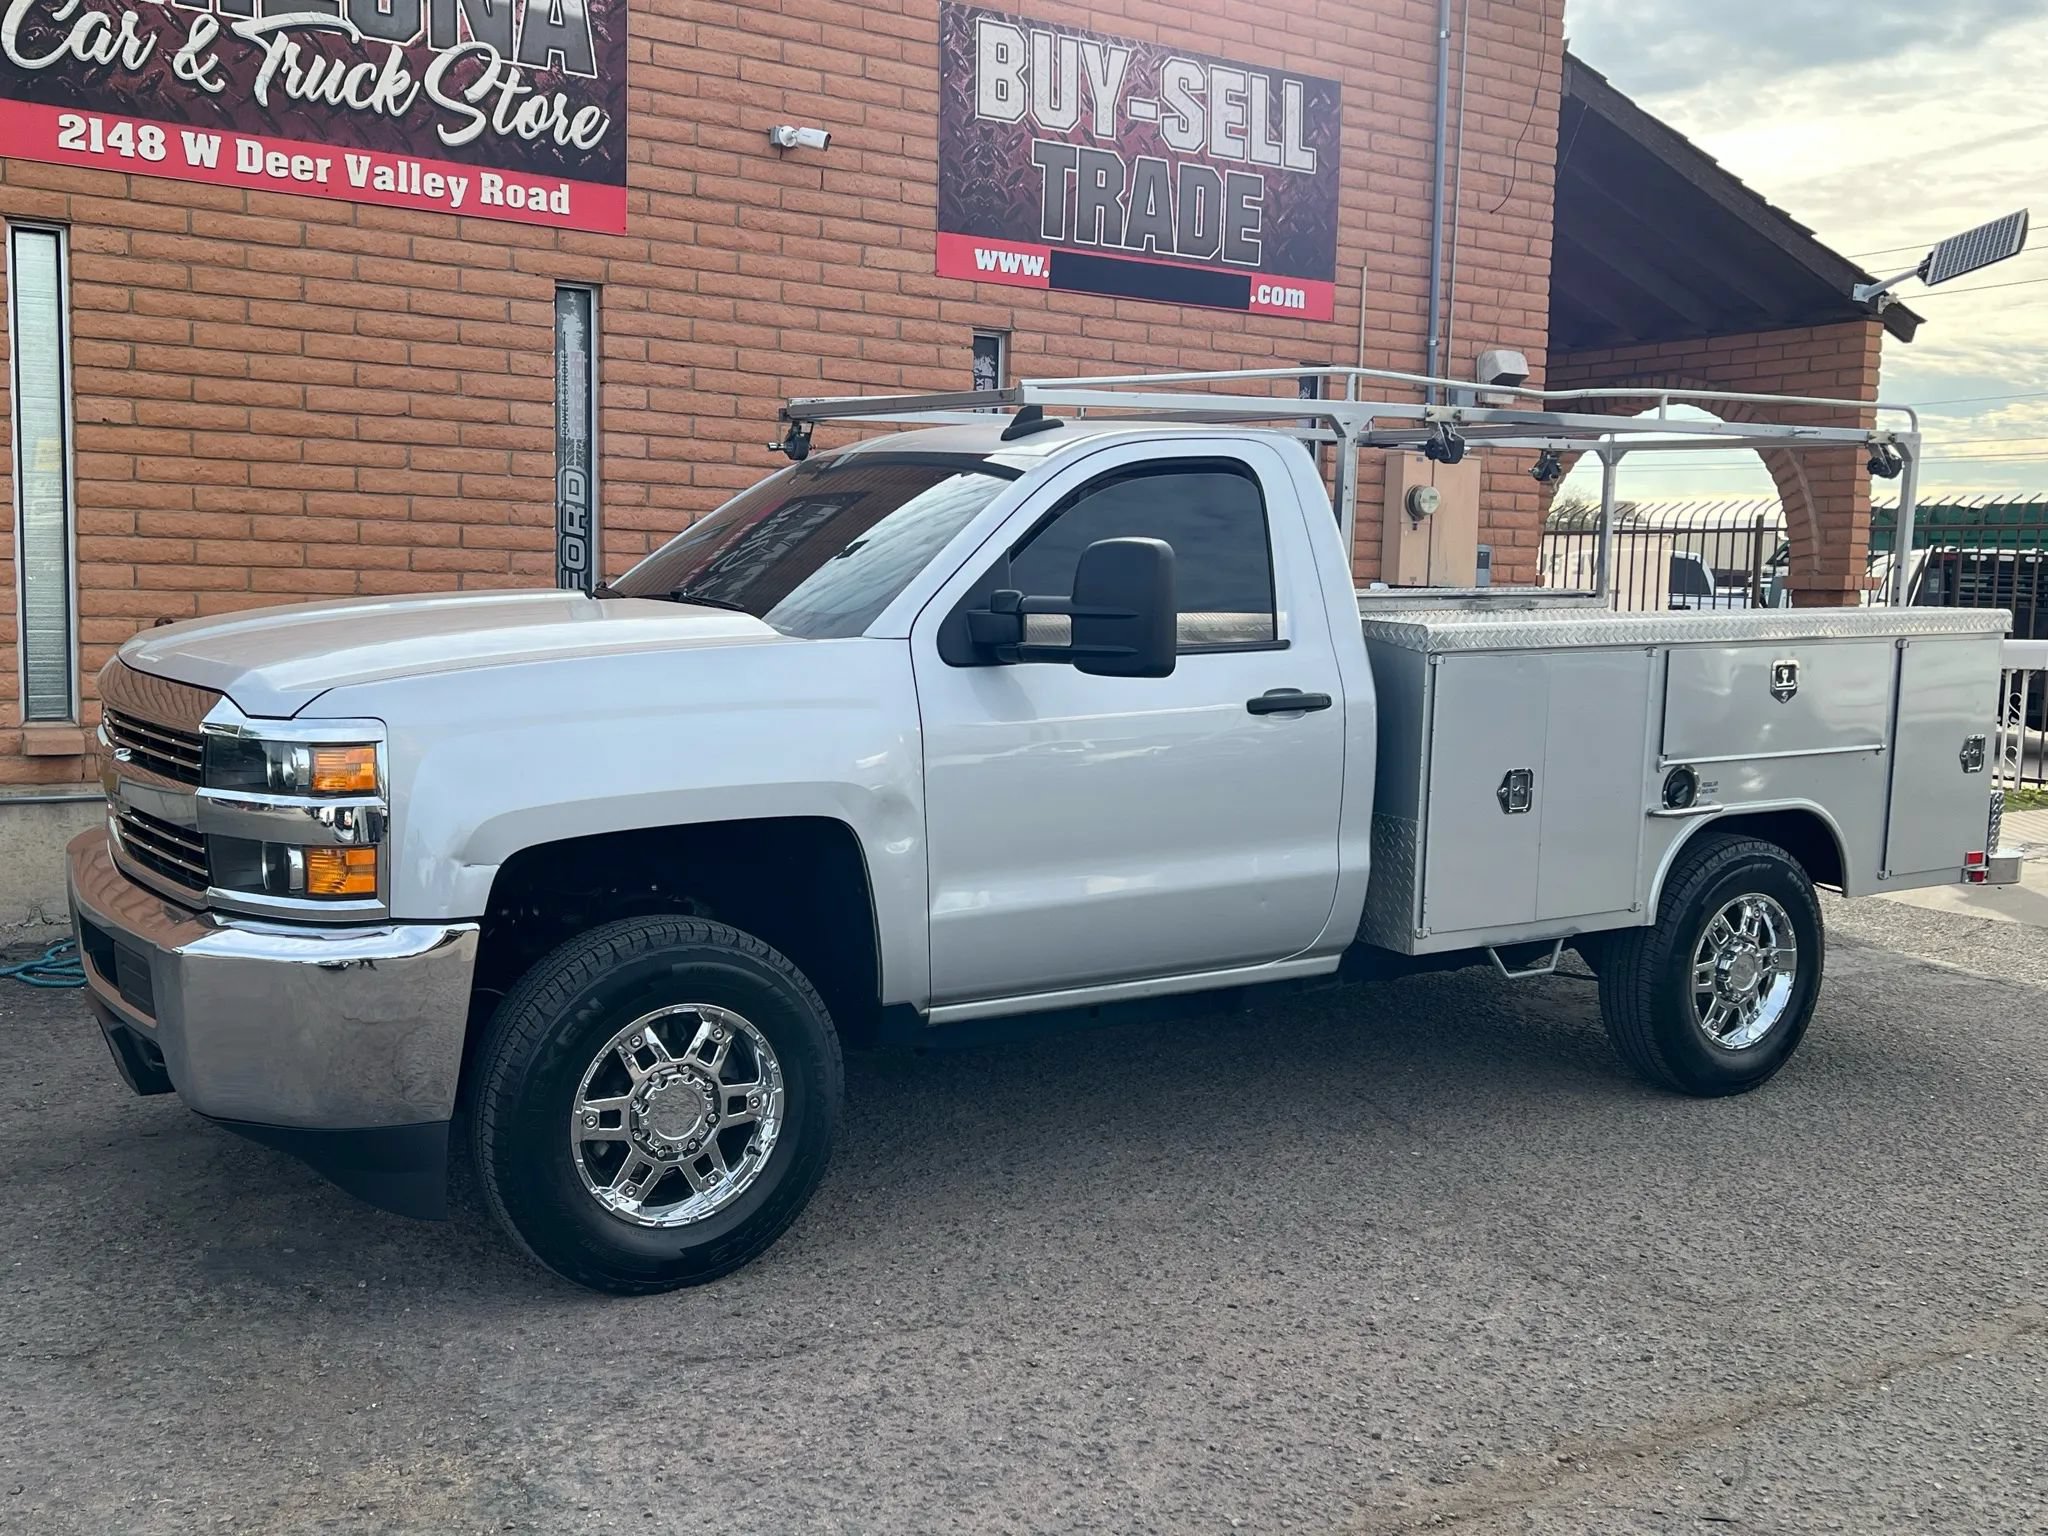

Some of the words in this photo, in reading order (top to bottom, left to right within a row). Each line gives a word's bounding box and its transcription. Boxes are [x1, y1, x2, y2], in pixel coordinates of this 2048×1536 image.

[1, 0, 157, 70] Car
[173, 14, 225, 93] &
[232, 13, 421, 117] Truck
[424, 41, 610, 150] Store
[975, 17, 1317, 174] BUY-SELL
[57, 114, 167, 161] 2148
[182, 132, 221, 169] W
[236, 139, 332, 184] Deer
[344, 153, 469, 208] Valley
[480, 173, 571, 215] Road
[1032, 138, 1264, 267] TRADE
